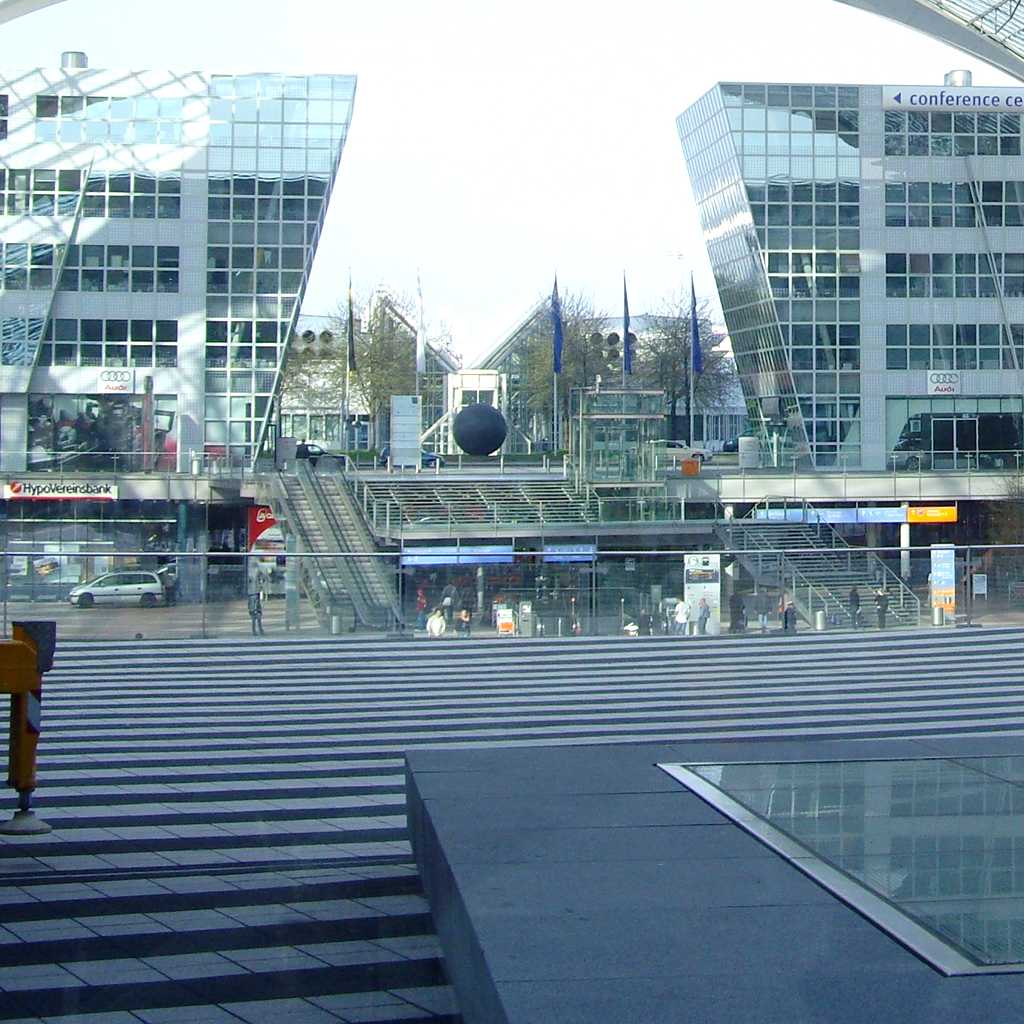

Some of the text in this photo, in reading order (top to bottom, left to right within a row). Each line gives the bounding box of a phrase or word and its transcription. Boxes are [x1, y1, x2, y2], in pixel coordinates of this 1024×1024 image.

[909, 90, 1000, 107] conference
[934, 385, 955, 393] Audi
[23, 482, 112, 496] HypoVereinsbank
